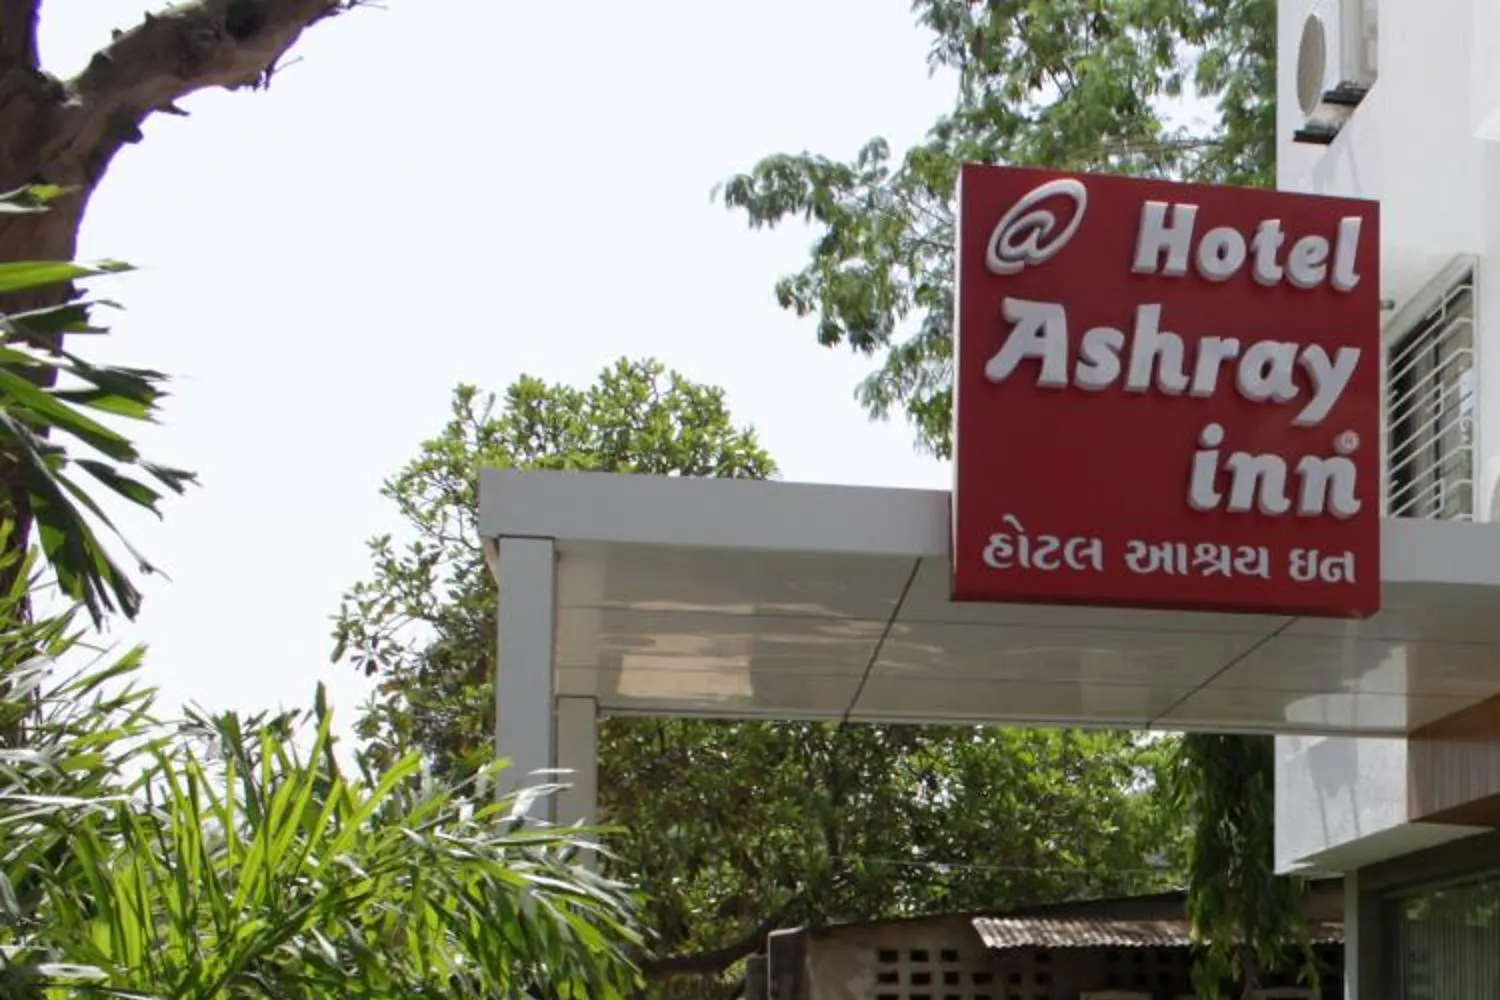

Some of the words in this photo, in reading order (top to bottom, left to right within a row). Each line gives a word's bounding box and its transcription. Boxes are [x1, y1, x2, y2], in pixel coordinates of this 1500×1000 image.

[1132, 200, 1363, 292] Hotel
[984, 296, 1361, 427] Ashray
[1186, 422, 1361, 519] inn
[982, 513, 1104, 572] હોટલ
[1124, 540, 1271, 578] આશ્રય
